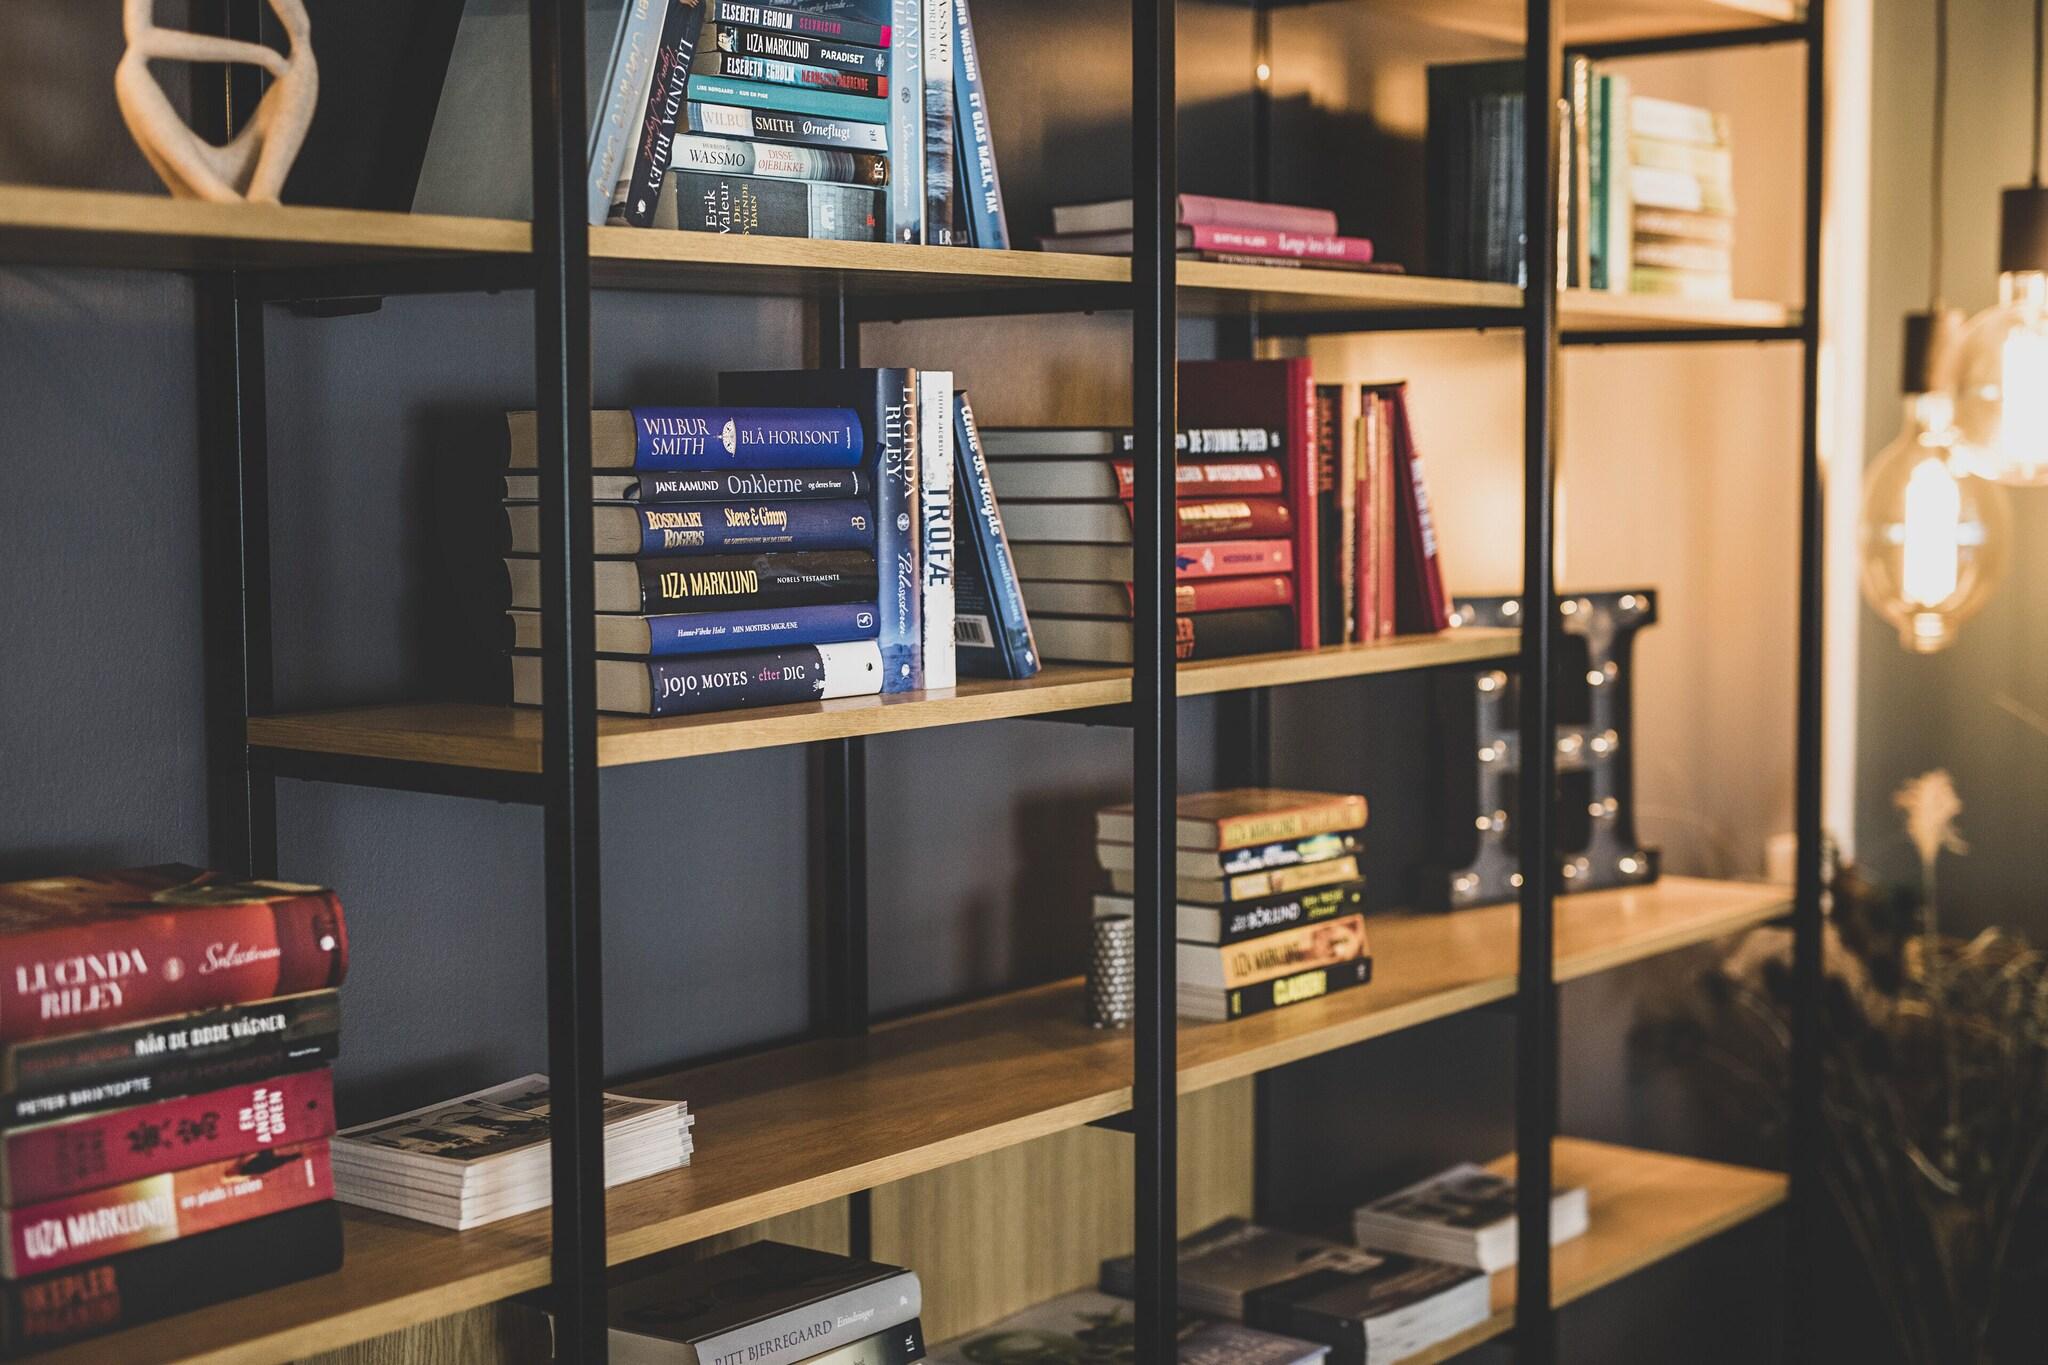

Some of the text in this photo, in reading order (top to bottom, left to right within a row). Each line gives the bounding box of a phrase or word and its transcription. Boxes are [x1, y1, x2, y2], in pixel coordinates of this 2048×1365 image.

[722, 3, 759, 25] ELSEBETH
[763, 11, 793, 30] EGHOLM
[746, 33, 864, 65] LIZA MARKLUND PARADISET
[960, 28, 977, 82] WASSMO
[727, 57, 763, 78] ELSEBETH
[765, 61, 795, 82] EGHOLM
[969, 92, 981, 107] ET
[648, 37, 694, 195] LUCINDA RILEY
[702, 111, 850, 141] WILBU SMITH Ørneflugt
[972, 111, 987, 143] GLAS
[689, 148, 746, 167] WASSMO
[758, 159, 805, 173] ØJEBLIKKE
[768, 149, 793, 161] DISSE
[704, 189, 717, 228] Erik
[719, 181, 730, 234] Valeur
[733, 197, 741, 223] DET
[750, 195, 758, 228] BARN
[984, 189, 999, 214] TAK
[644, 418, 710, 436] WILBUR
[741, 427, 764, 445] BLÅ
[768, 430, 840, 445] HORISONT
[651, 437, 705, 455] SMITH
[885, 404, 902, 481] RILEY
[902, 386, 916, 499] LUCINDA
[655, 481, 677, 494] JANE
[678, 479, 719, 492] AAMUND
[727, 473, 802, 494] Onklerne
[808, 482, 816, 490] og
[815, 481, 828, 489] deres
[960, 405, 979, 452] Anne
[979, 476, 1000, 536] Ragde
[645, 511, 704, 530] ROSEMARY
[724, 507, 787, 532] Steve & Ginny
[664, 529, 705, 549] ROGERS
[928, 489, 951, 587] TROFÆ
[661, 570, 840, 599] LIZA MARKLUND NOBELS TESTAMENTE
[732, 625, 744, 633] MIN
[745, 623, 770, 632] MOSTERS
[771, 621, 798, 631] MIGRÆNE
[662, 665, 806, 698] JOJO MOYES efter DIG
[16, 947, 148, 995] LUCINDA
[40, 981, 123, 1020] RILEY
[135, 1031, 167, 1057] NÅR
[168, 1029, 189, 1050] DE
[239, 1107, 254, 1131] EN
[253, 1088, 273, 1144] ANDEN
[269, 1090, 286, 1135] GREN
[23, 1195, 174, 1260] LIZA MARKLUND
[747, 1319, 833, 1362] BJERREGAARD
